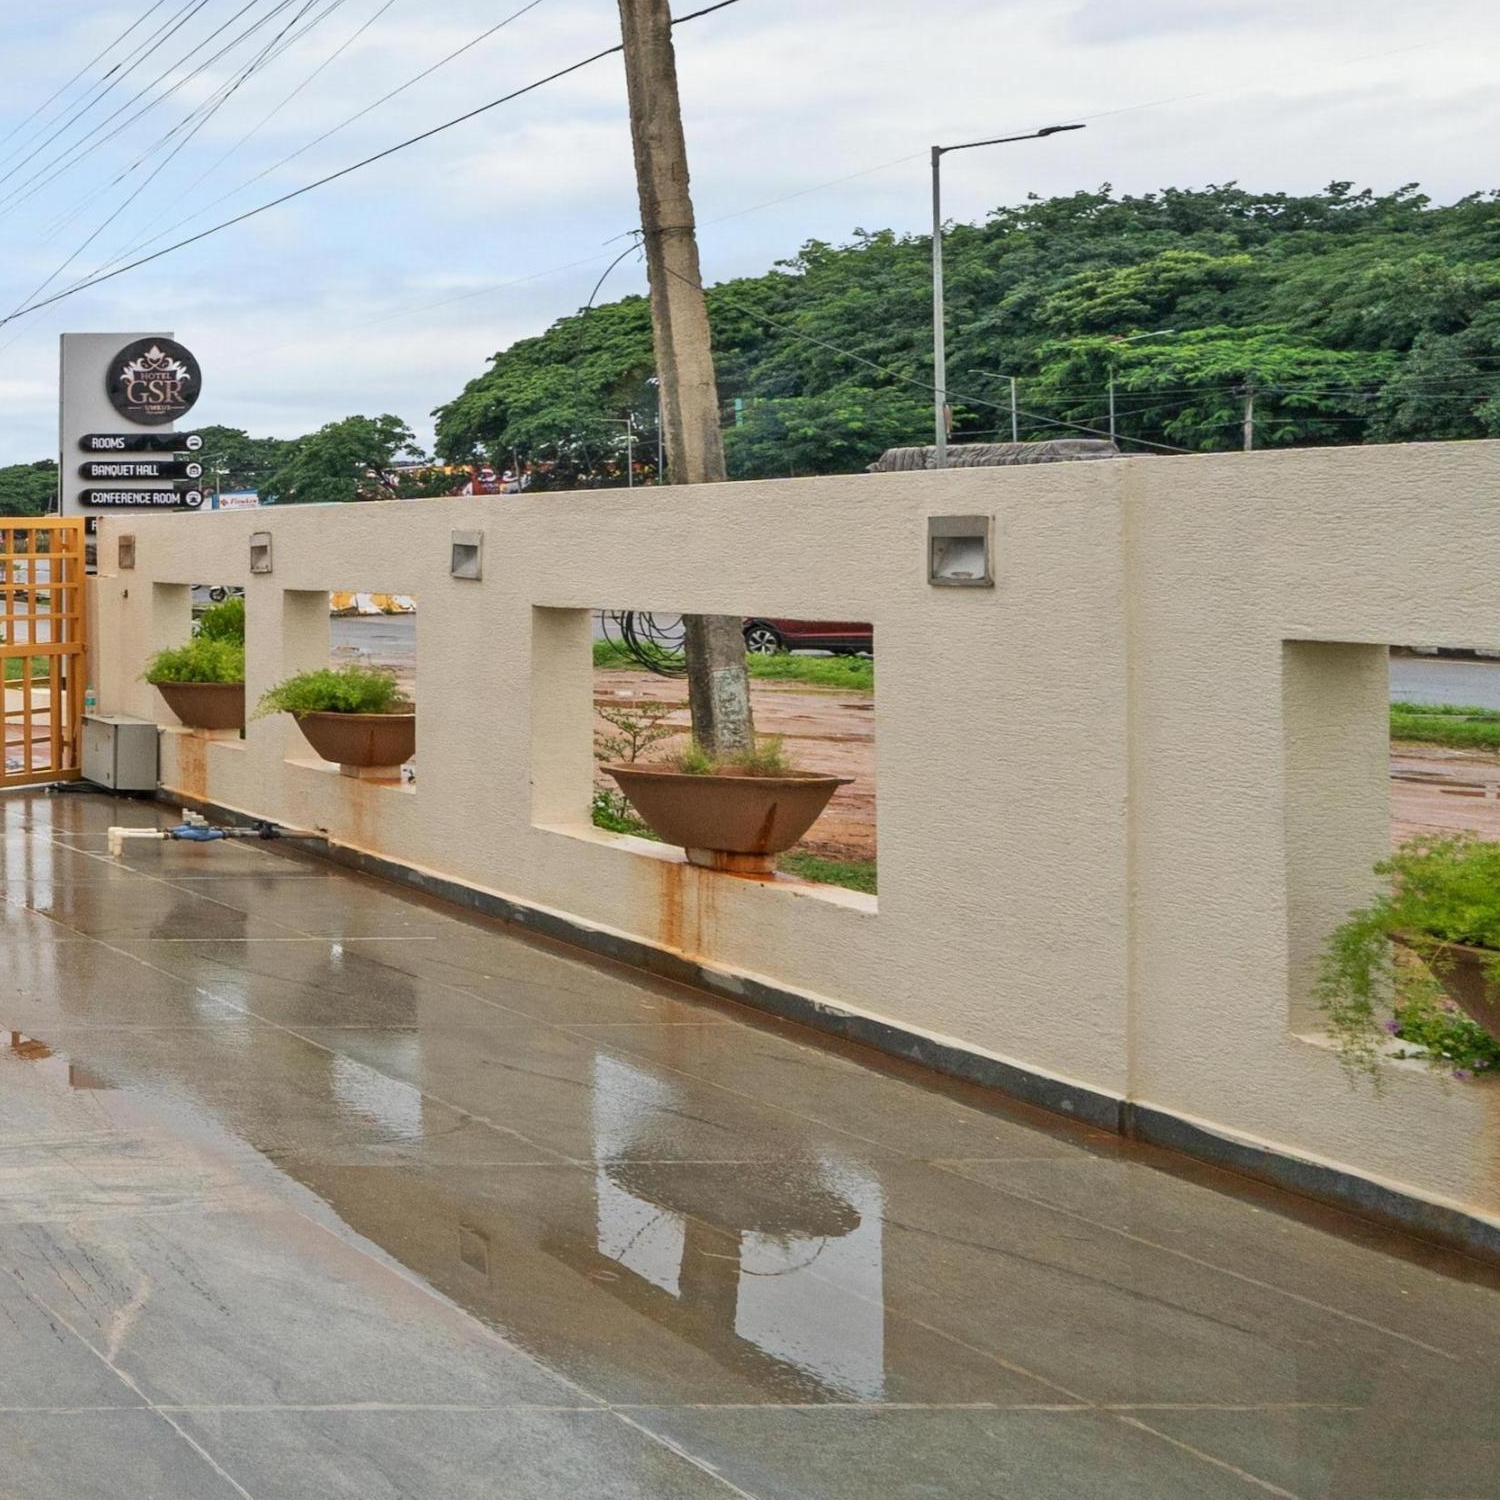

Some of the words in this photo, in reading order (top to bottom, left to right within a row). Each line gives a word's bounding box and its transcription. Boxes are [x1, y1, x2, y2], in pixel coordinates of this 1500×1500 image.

[140, 372, 172, 380] HOTEL
[127, 380, 186, 404] GSR
[91, 437, 126, 449] ROOMS
[91, 464, 135, 477] BANQUET
[136, 464, 160, 476] HALL
[91, 492, 152, 504] CONFERENCE
[152, 492, 181, 504] ROOM
